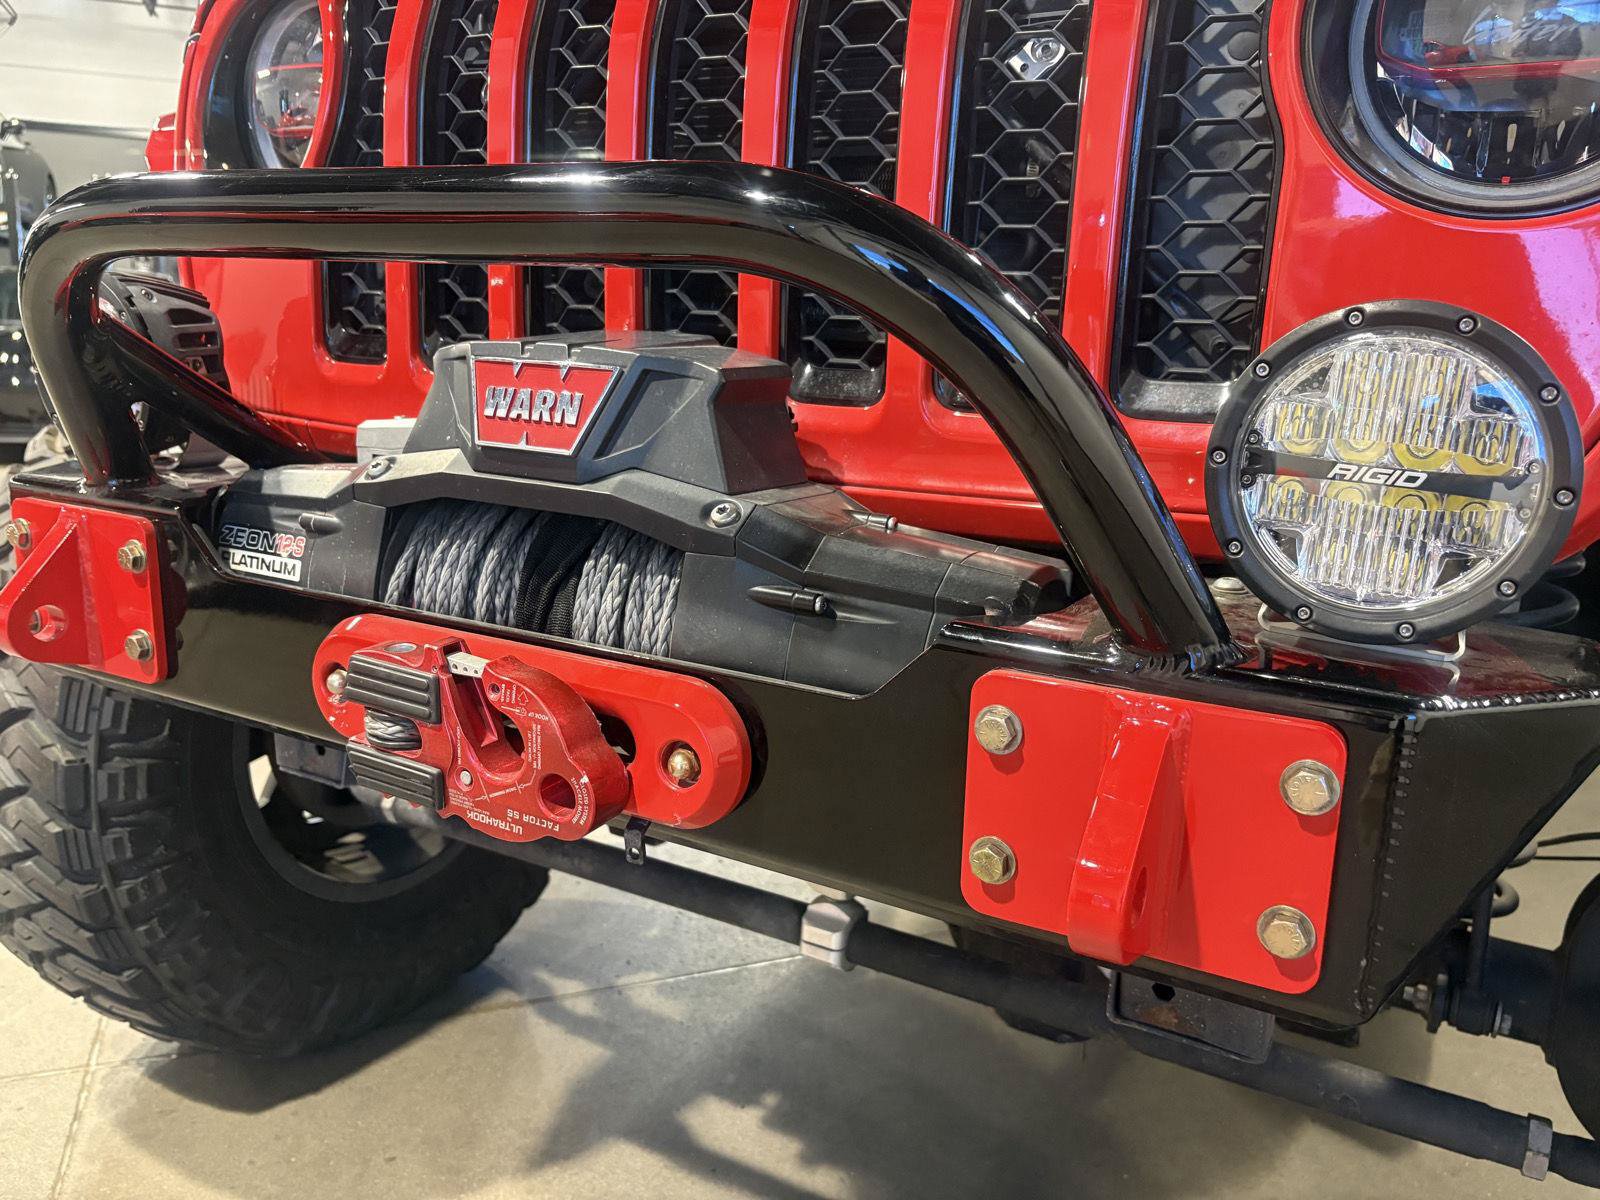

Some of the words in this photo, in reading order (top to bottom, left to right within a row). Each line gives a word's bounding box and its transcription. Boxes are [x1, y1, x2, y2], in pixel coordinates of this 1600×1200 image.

[484, 385, 584, 427] WARN
[1327, 463, 1428, 488] RIGID
[466, 809, 523, 835] ULTRAHOOK
[523, 814, 560, 832] FACTOR
